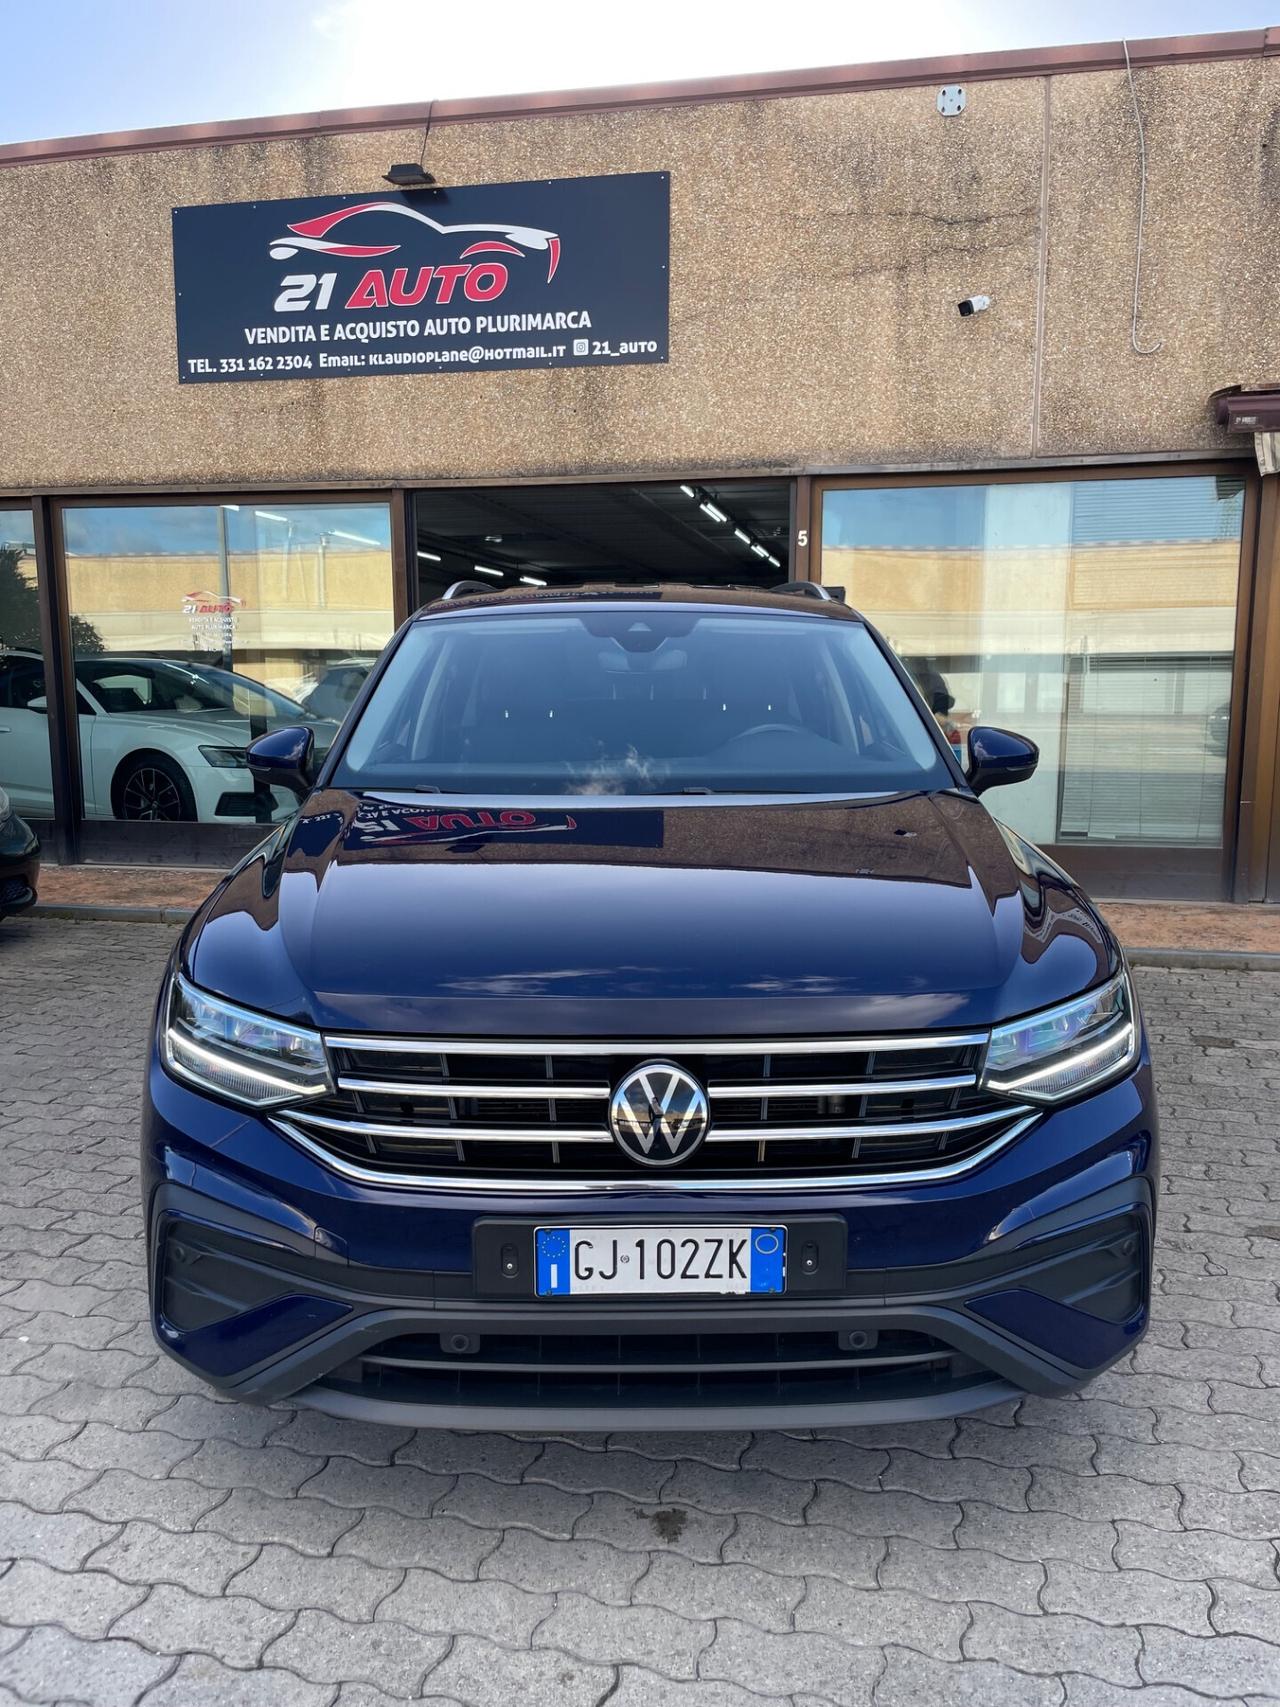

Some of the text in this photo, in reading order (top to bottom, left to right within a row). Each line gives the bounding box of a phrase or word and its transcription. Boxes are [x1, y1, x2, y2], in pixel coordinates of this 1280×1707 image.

[273, 262, 508, 312] 21 AUTO
[244, 310, 592, 345] VENDITA E ACQUISTO AUTO PLURIMARCA
[188, 359, 217, 373] TEL.
[220, 358, 245, 373] 331
[249, 356, 273, 371] 162
[276, 354, 312, 369] 2304
[797, 530, 808, 547] 5
